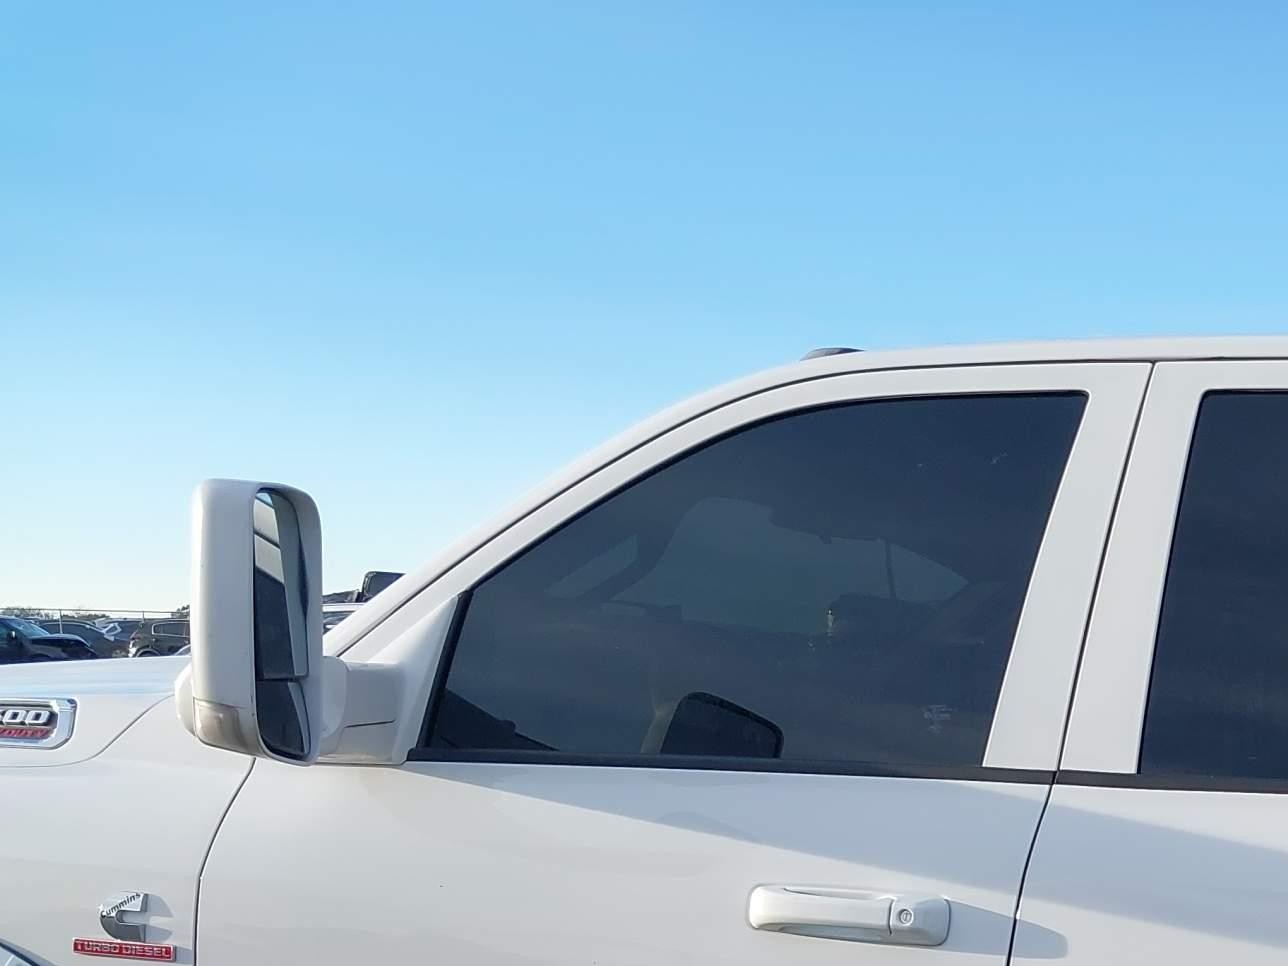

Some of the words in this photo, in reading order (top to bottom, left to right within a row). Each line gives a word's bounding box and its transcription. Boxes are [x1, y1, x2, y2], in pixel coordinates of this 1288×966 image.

[100, 892, 140, 918] Cummins
[76, 941, 119, 954] TURBO
[122, 944, 171, 957] DIESEL
